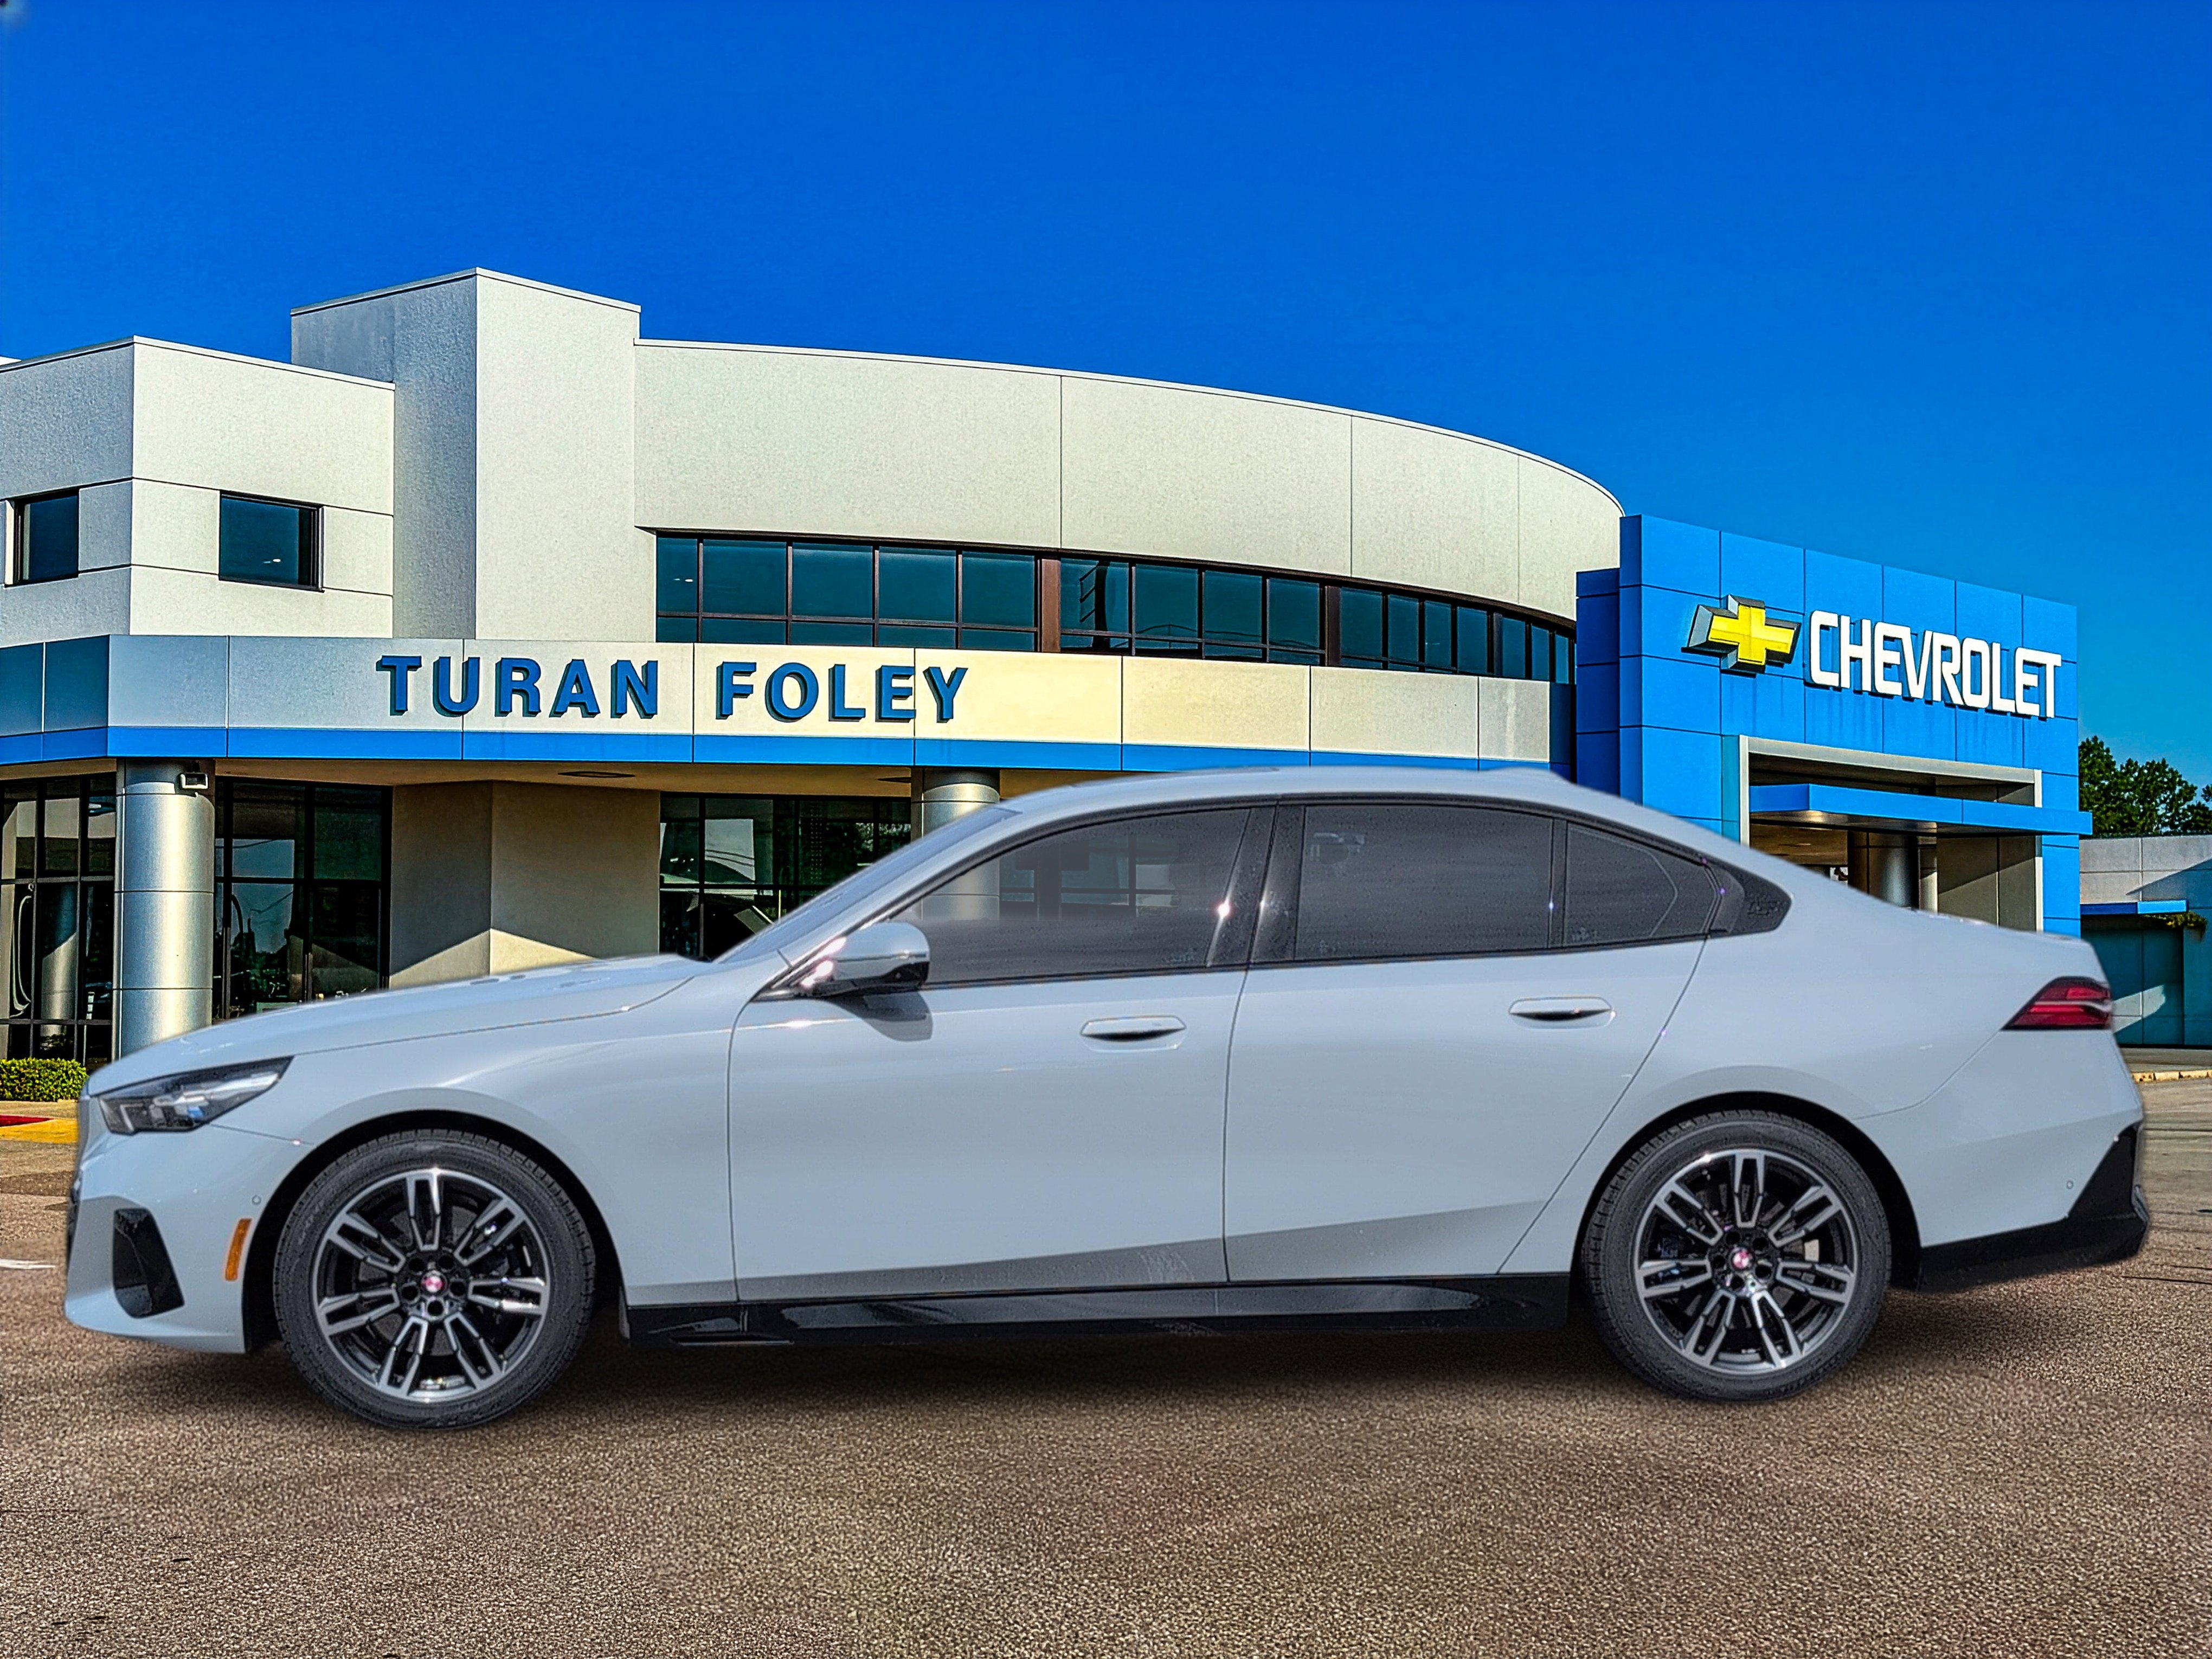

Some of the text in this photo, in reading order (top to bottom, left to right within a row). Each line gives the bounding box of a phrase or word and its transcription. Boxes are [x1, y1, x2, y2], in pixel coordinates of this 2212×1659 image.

[376, 655, 968, 722] TURAN FOLEY
[1810, 610, 2062, 718] CHEVROLET
